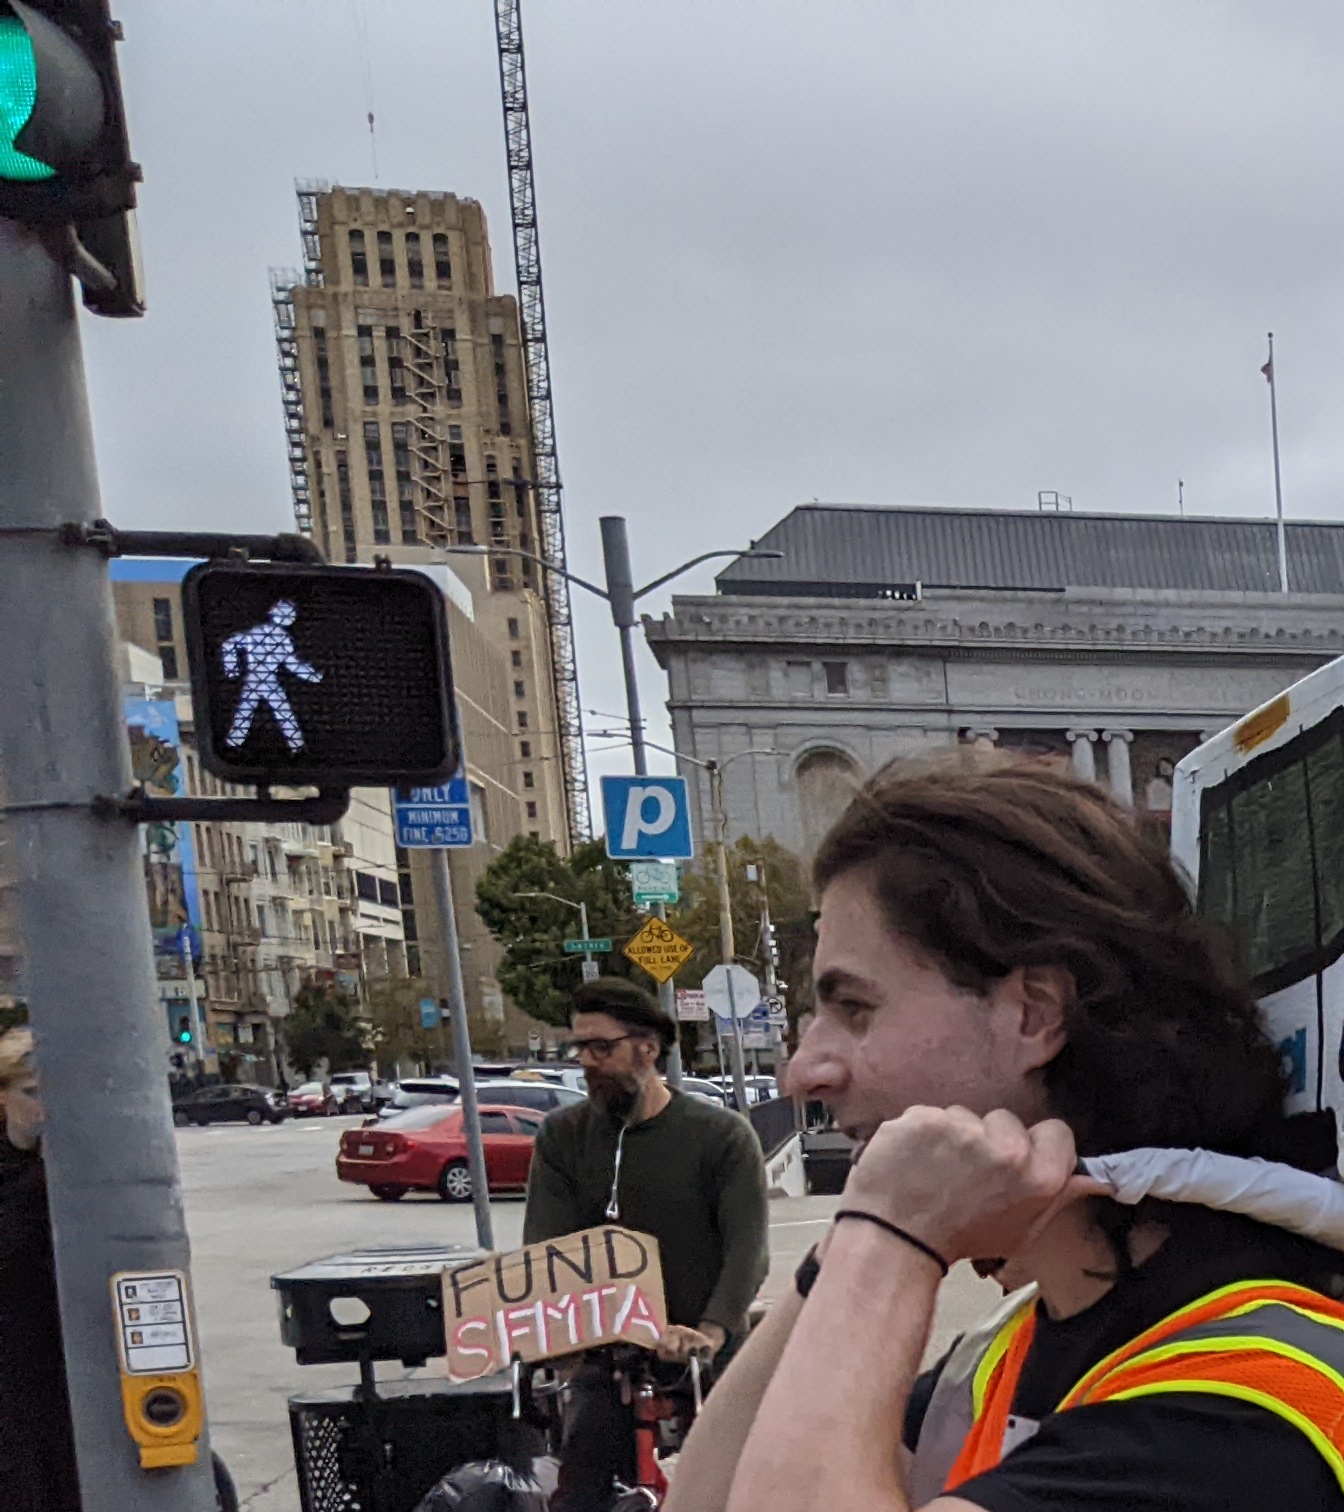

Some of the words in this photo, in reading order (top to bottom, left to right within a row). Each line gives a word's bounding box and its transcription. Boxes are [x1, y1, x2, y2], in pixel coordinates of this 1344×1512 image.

[408, 810, 459, 825] MINIMUM
[403, 827, 429, 842] FINE
[628, 945, 661, 954] ALLOWED
[663, 944, 678, 953] USE
[638, 956, 656, 965] FULL
[660, 955, 681, 963] LANE
[450, 1228, 648, 1318] FUND
[450, 1283, 666, 1382] SFMTA
